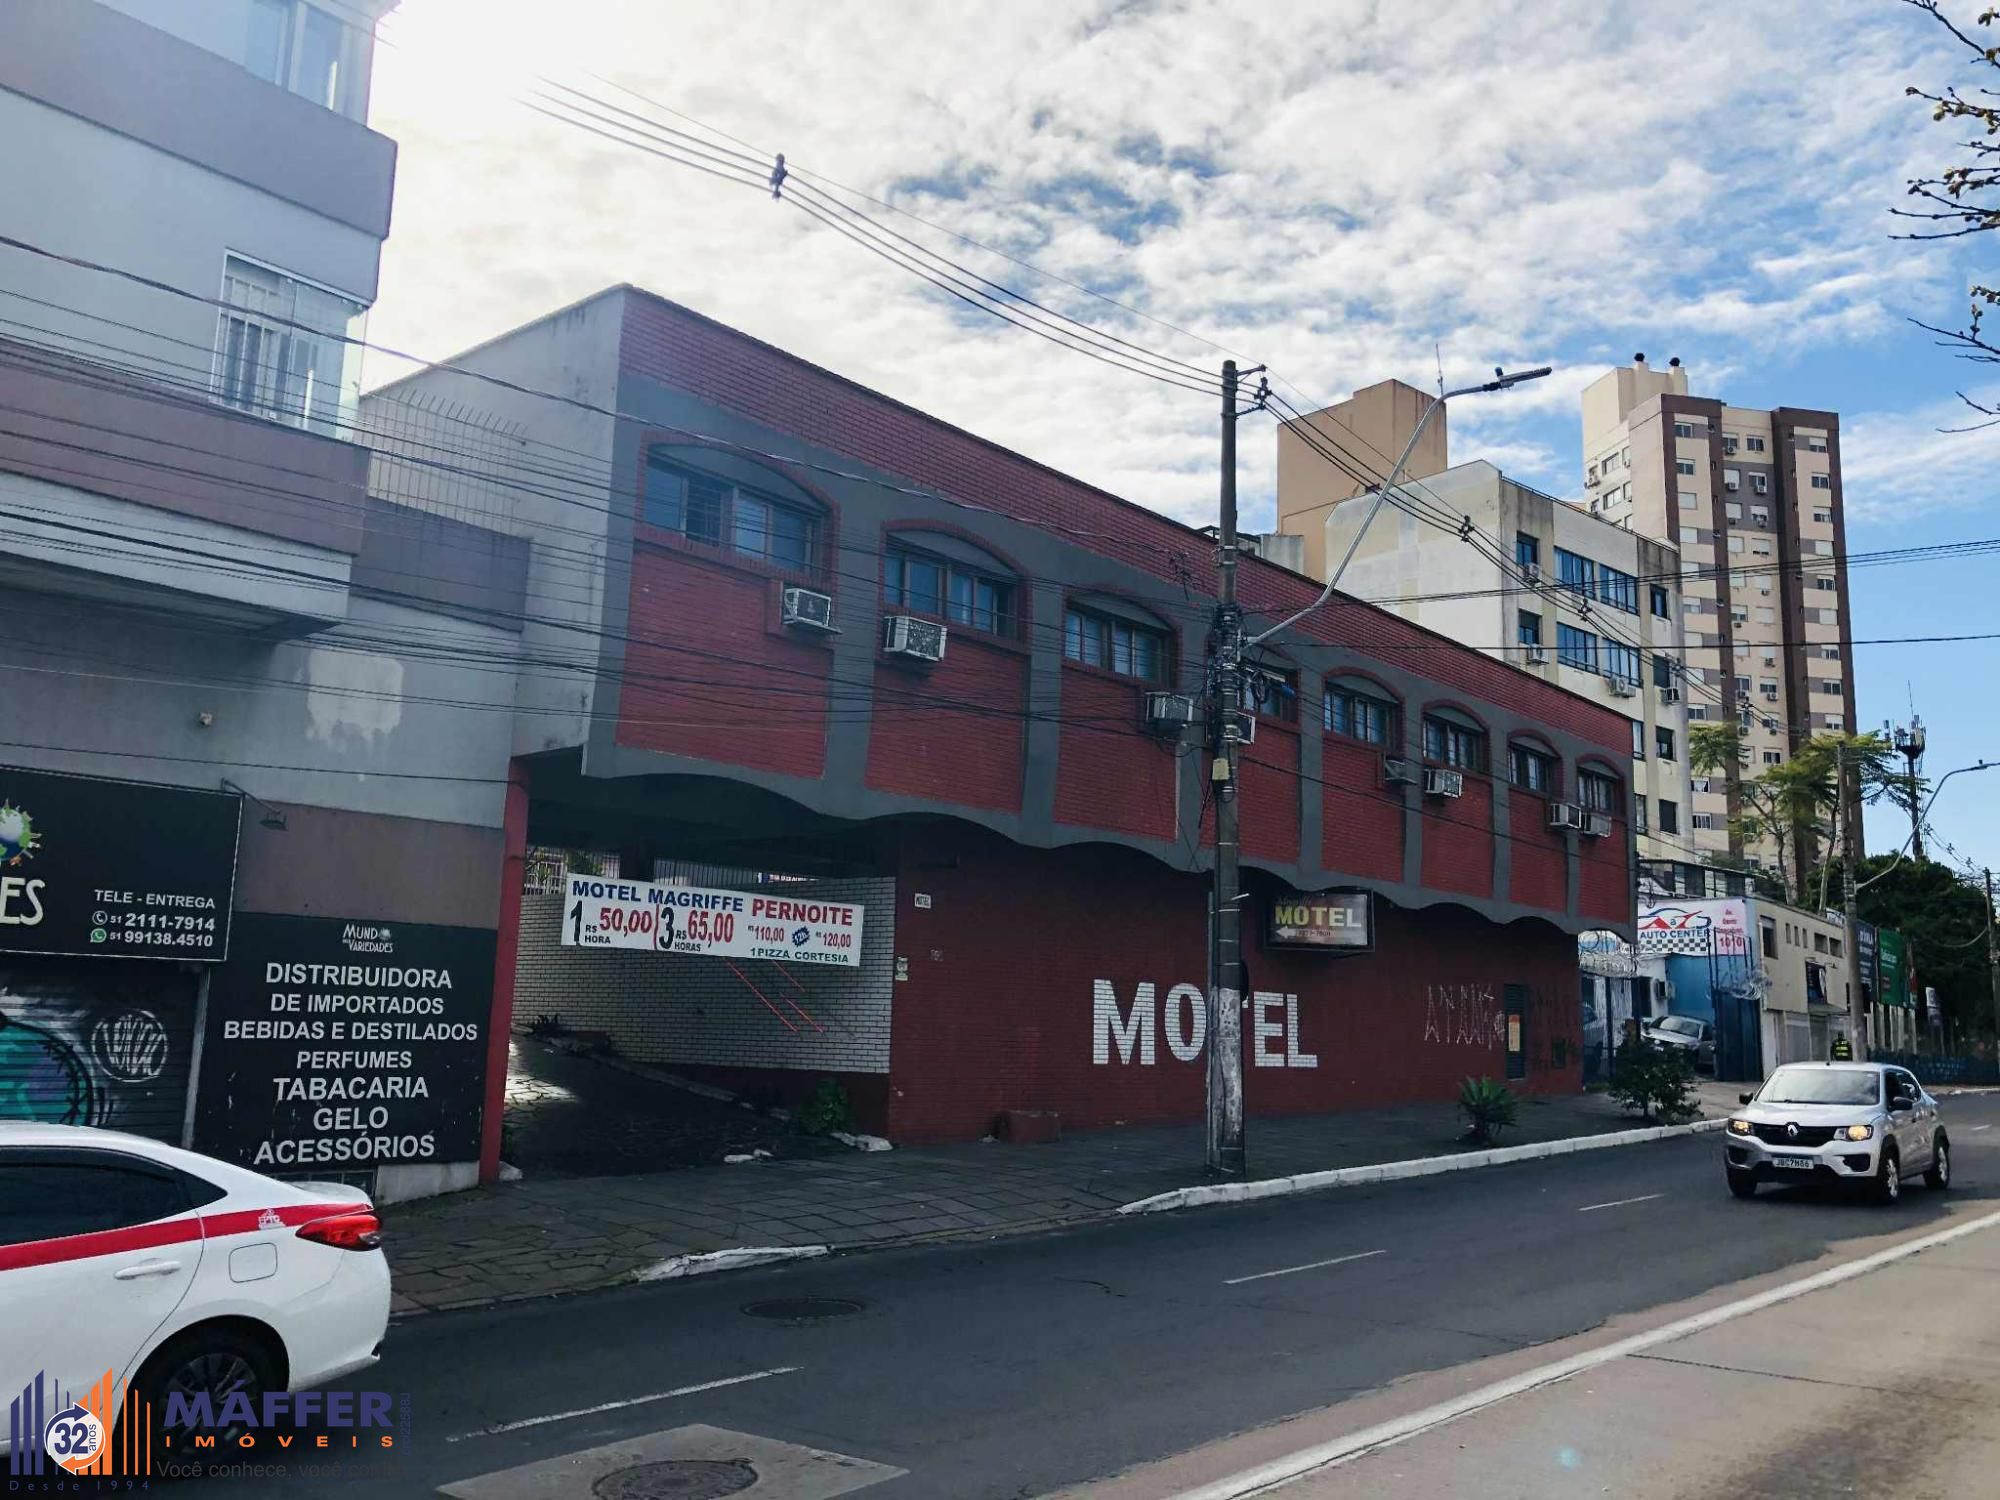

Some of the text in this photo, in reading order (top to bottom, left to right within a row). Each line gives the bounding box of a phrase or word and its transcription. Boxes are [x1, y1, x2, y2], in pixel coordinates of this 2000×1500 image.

[94, 889, 133, 903] TELE
[146, 893, 216, 909] ENTREGA
[572, 880, 744, 913] MOTEL MAGRIFFE
[110, 912, 215, 931] 51 2111-7914
[570, 900, 583, 943] 1
[600, 907, 653, 937] 50,00
[752, 898, 853, 927] PERNOITE
[1274, 905, 1362, 928] MOTEL
[110, 930, 213, 947] 51 99138.4510
[659, 906, 675, 950] 3
[688, 909, 734, 948] 65,00
[754, 925, 785, 944] 110,00
[822, 932, 852, 950] 120,00
[1640, 931, 1668, 939] AUTO
[1669, 928, 1711, 939] CENTER
[349, 939, 393, 953] VARIEDADES
[584, 935, 611, 944] HORA
[674, 942, 701, 952] HORAS
[758, 948, 790, 959] PIZZA
[794, 951, 849, 963] CORTESIA
[265, 962, 453, 989] DISTRIBUIDORA
[270, 993, 445, 1015] DE IMPORTADOS
[223, 1020, 478, 1041] BEBIDAS E DESTILADOS
[1093, 979, 1318, 1068] MOEL
[296, 1050, 412, 1070] PERFUMES
[272, 1076, 429, 1101] TABACARIA
[313, 1105, 389, 1131] GELO
[253, 1131, 436, 1165] ACESSÓRIOS
